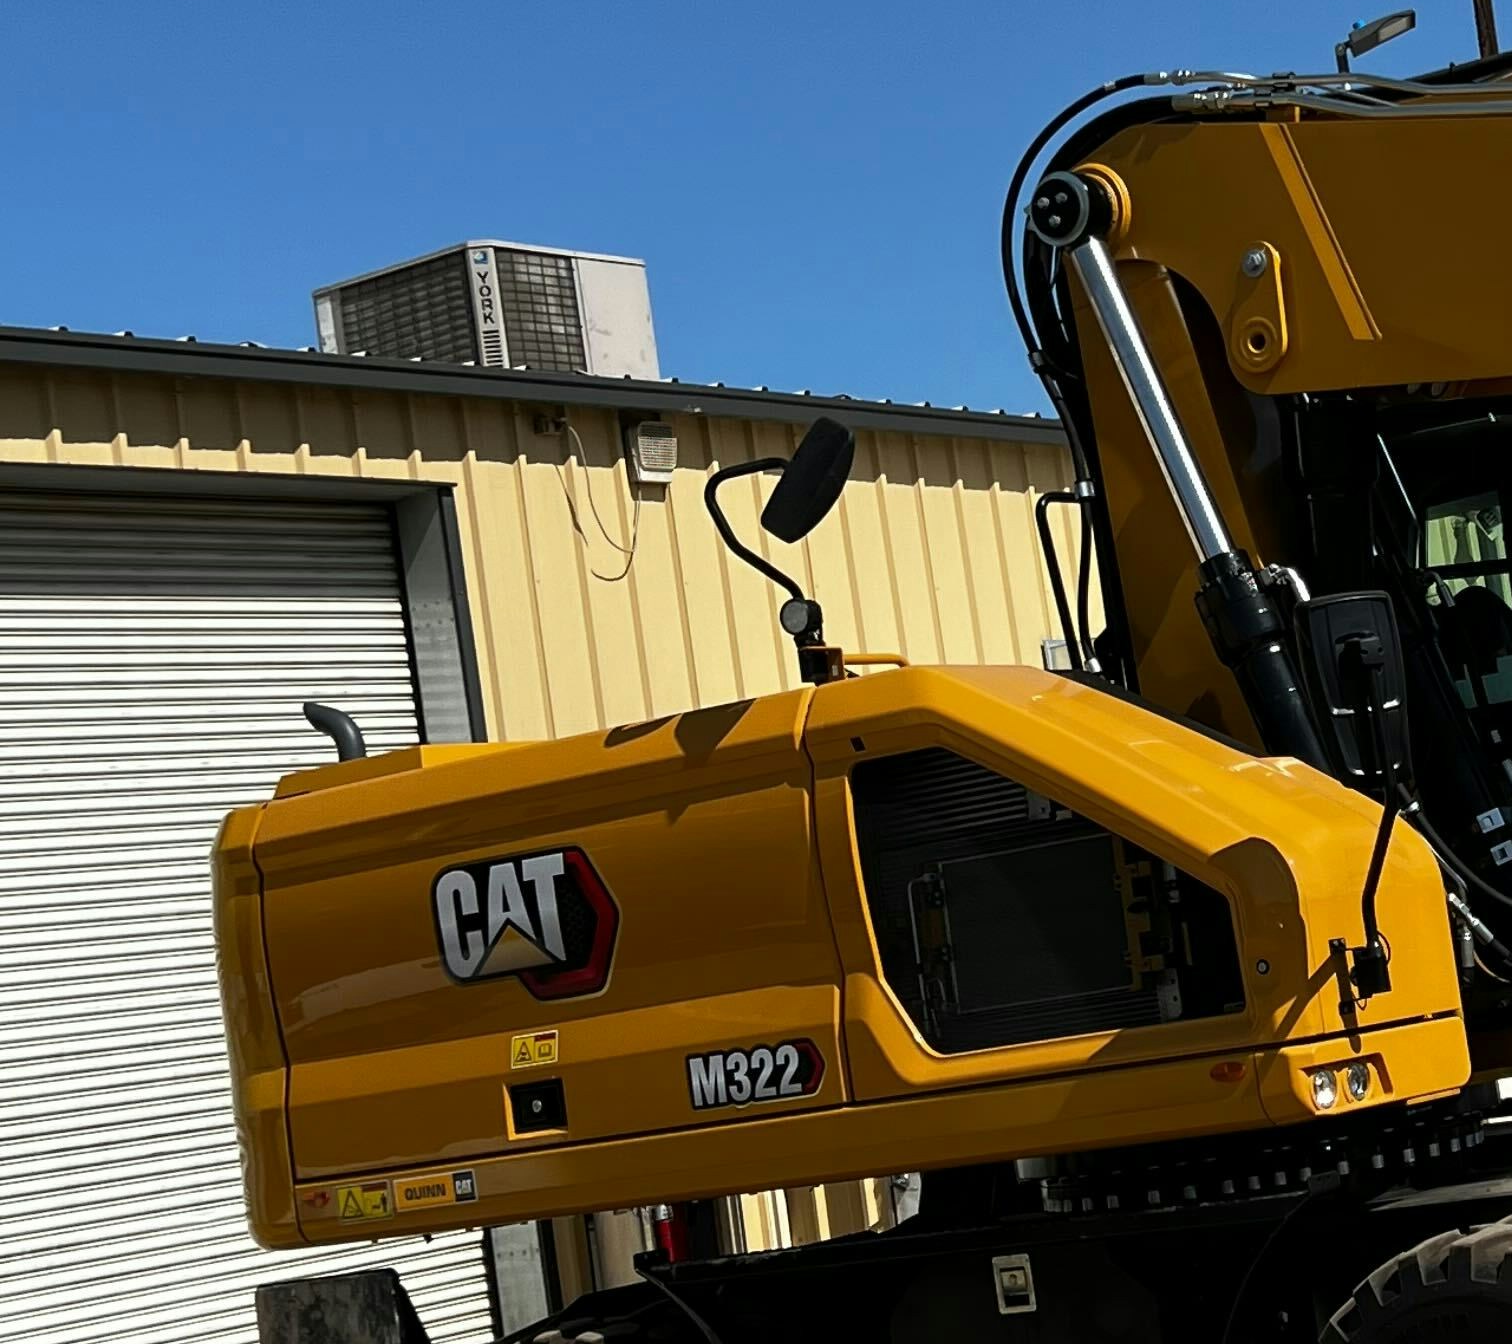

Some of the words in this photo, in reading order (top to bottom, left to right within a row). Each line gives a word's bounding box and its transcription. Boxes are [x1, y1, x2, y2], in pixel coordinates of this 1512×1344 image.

[476, 271, 495, 324] YORK
[436, 852, 567, 978] CAT
[689, 1044, 803, 1107] M322
[405, 1183, 447, 1201] QUINN
[455, 1179, 473, 1195] CAT
